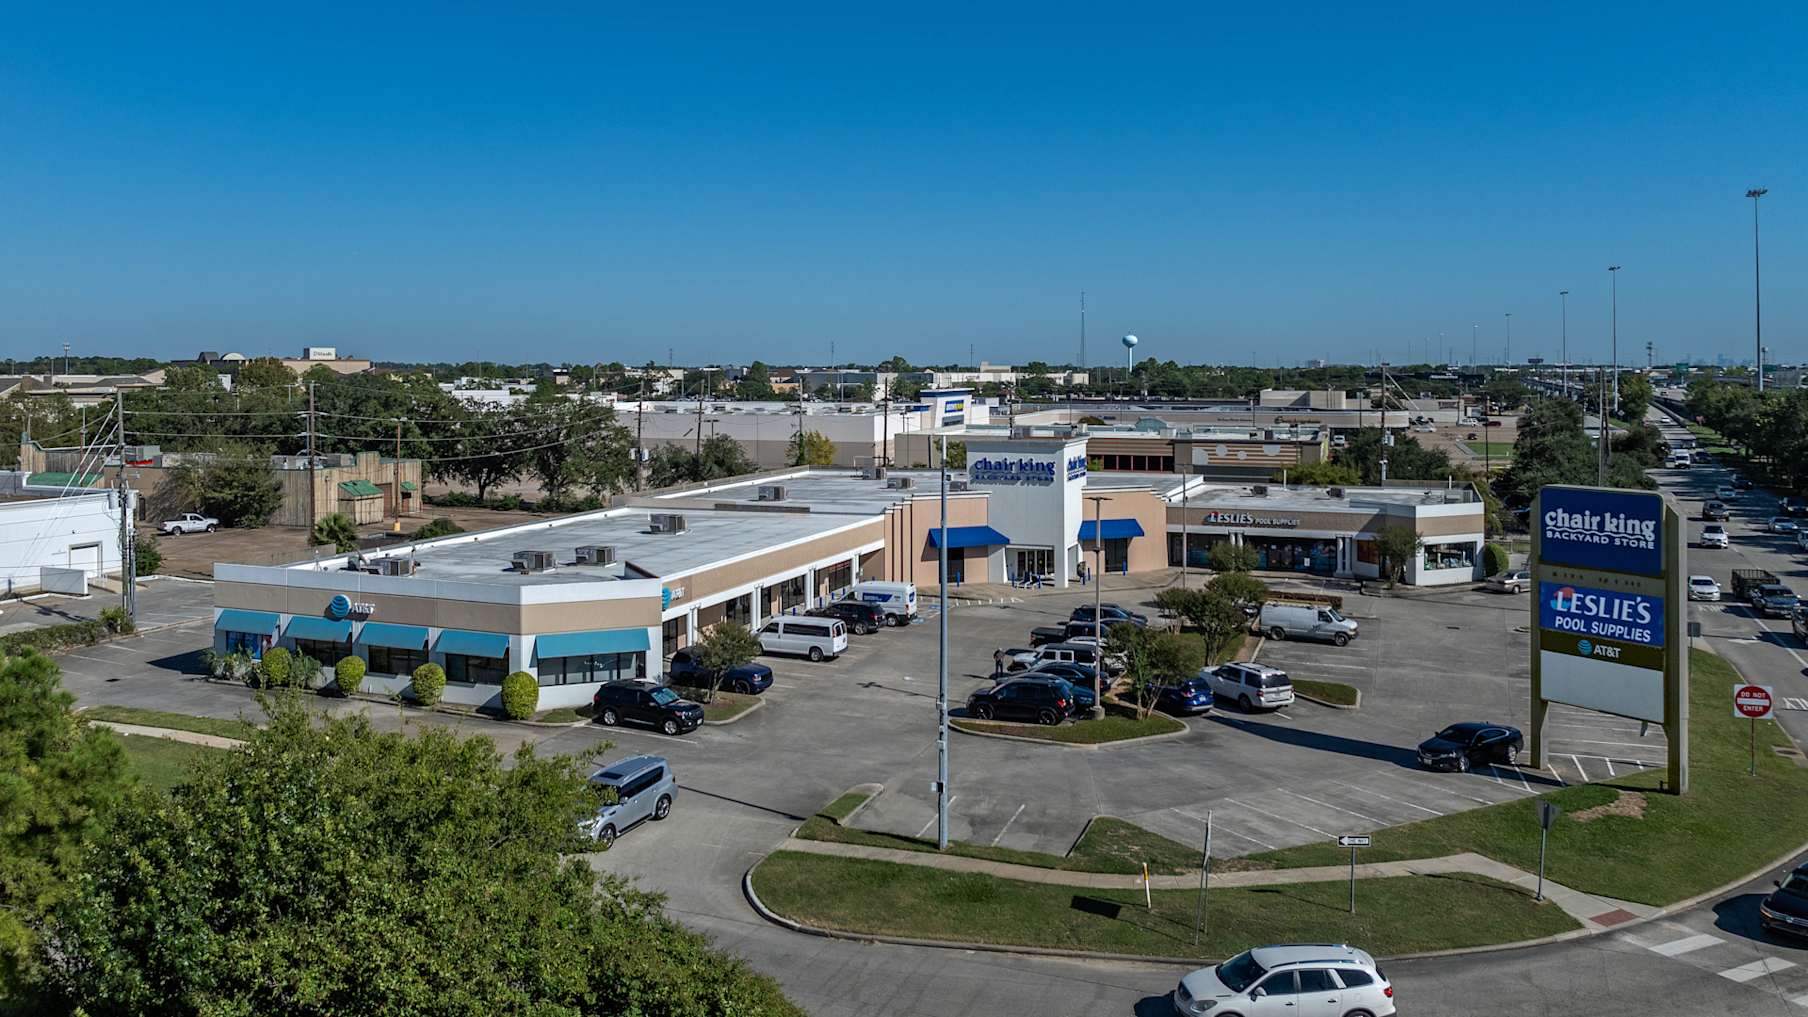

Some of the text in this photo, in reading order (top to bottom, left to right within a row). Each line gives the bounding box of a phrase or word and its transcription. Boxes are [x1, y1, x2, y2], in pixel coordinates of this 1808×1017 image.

[974, 457, 1016, 471] chair
[1019, 458, 1056, 476] king
[1210, 512, 1253, 524] LESLIE'S
[1545, 508, 1656, 541] chair king
[1546, 530, 1655, 550] BACKYARD STORE
[1556, 591, 1652, 625] LESLIE'S
[1555, 616, 1652, 643] POOL SUPPLIES
[1593, 645, 1621, 658] AT&T
